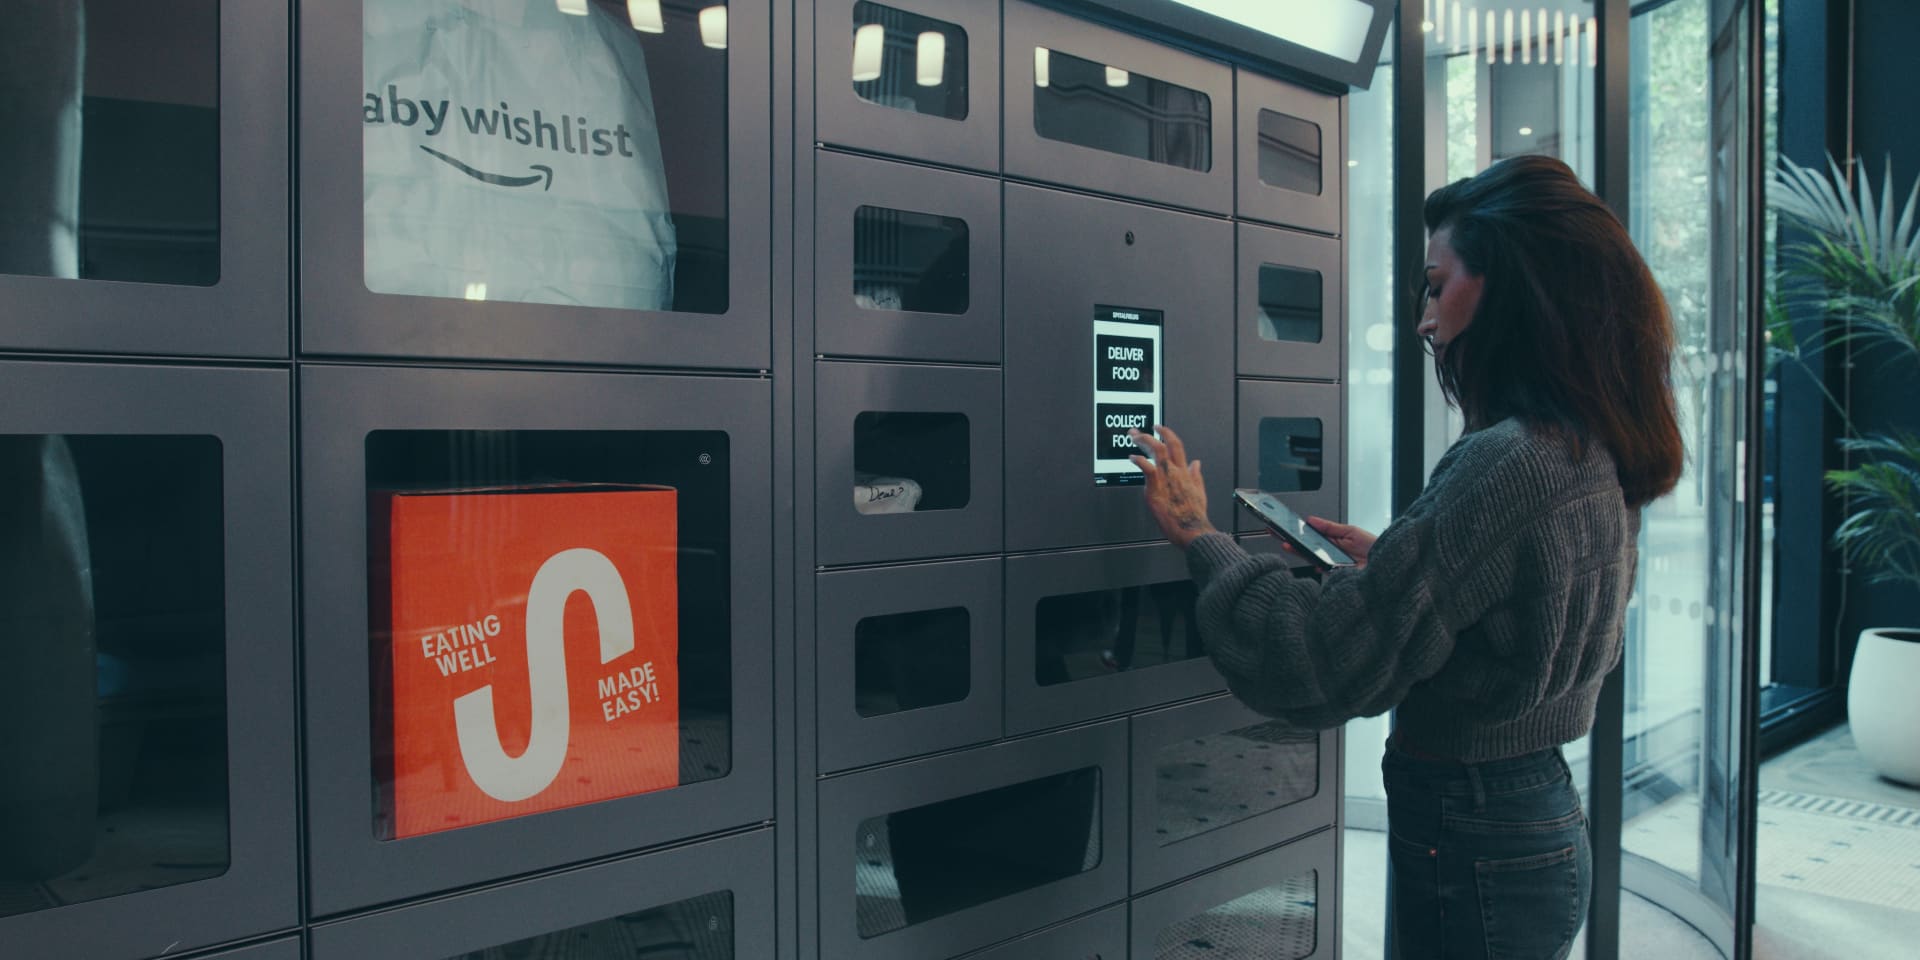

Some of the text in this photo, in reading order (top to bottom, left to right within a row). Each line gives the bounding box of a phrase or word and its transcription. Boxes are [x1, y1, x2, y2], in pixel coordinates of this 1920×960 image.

[461, 101, 633, 157] wishlist
[1108, 346, 1144, 361] DELIVER
[1112, 366, 1140, 380] FOOD
[1105, 414, 1147, 428] COLLECT
[1112, 434, 1138, 448] FOO
[421, 614, 501, 658] EATING
[435, 643, 497, 677] WELL
[598, 661, 656, 699] MADE
[602, 682, 660, 722] EASY!
